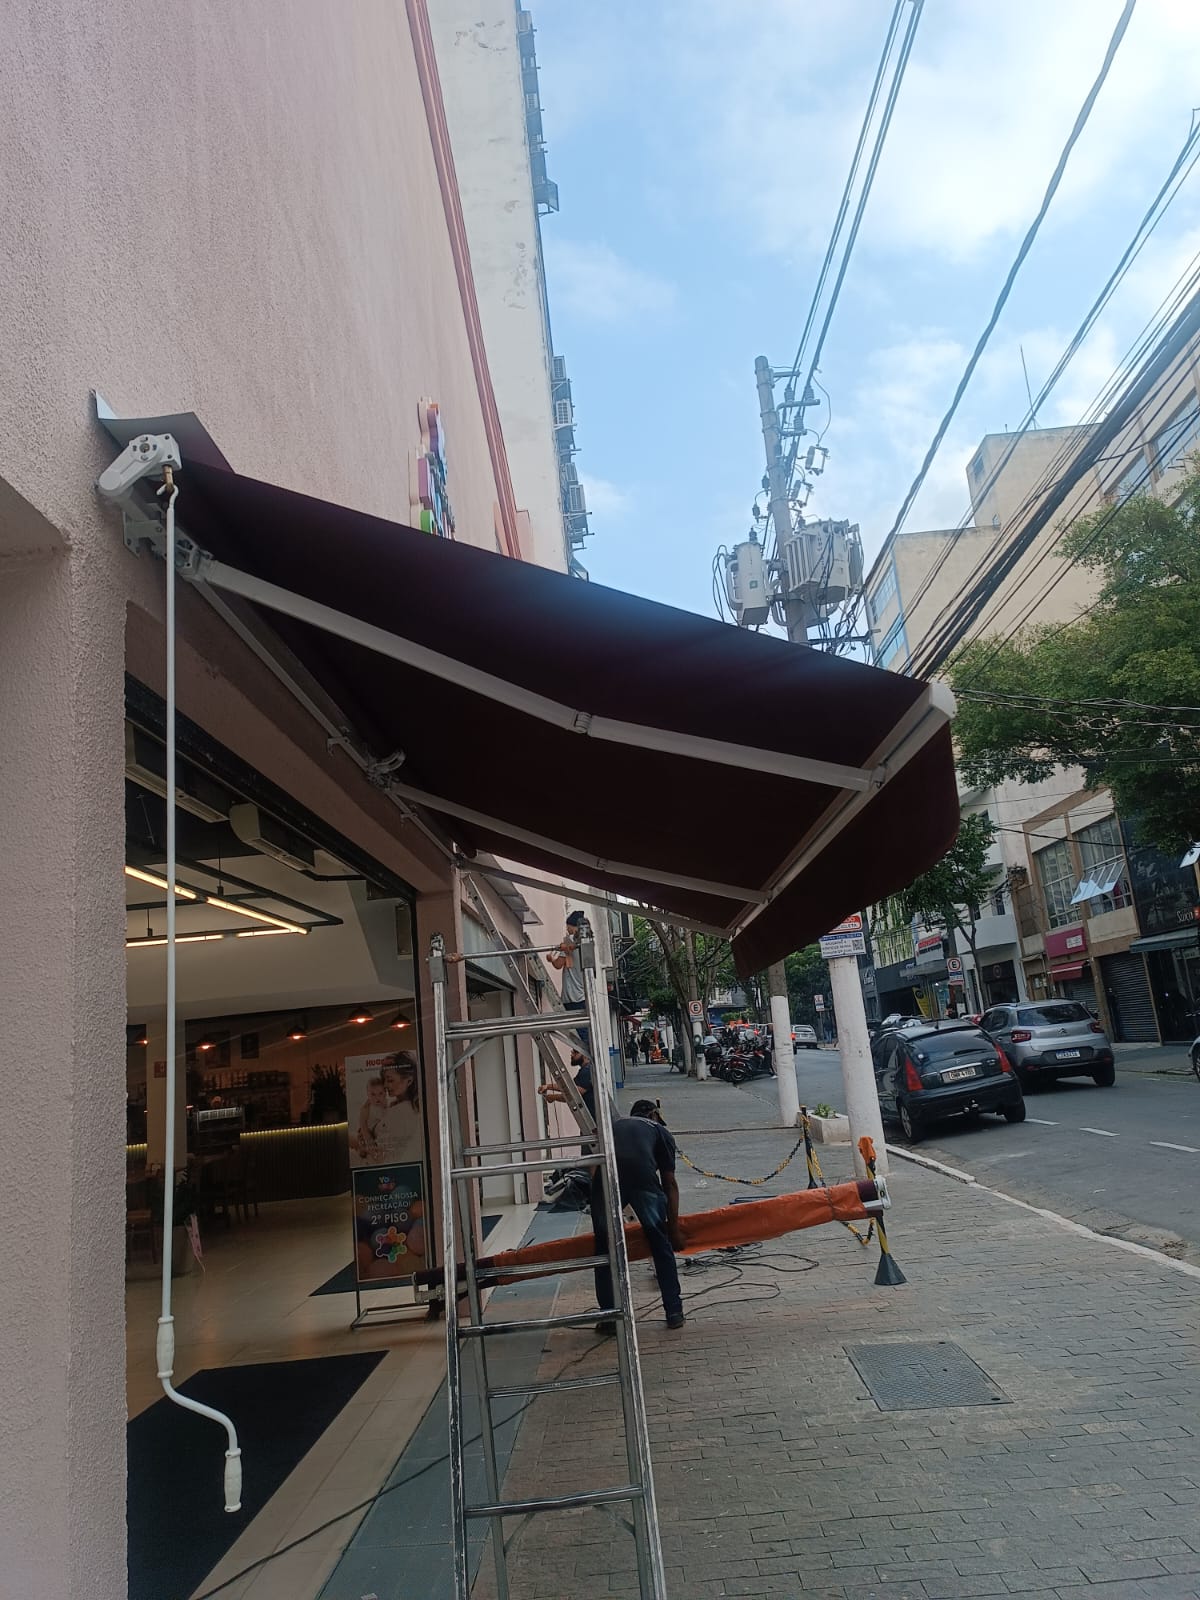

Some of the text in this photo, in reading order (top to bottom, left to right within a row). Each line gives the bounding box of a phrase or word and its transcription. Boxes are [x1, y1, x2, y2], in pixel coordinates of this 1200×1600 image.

[358, 1191, 418, 1204] CONHEÇA NOSSA
[384, 1211, 408, 1223] PISO
